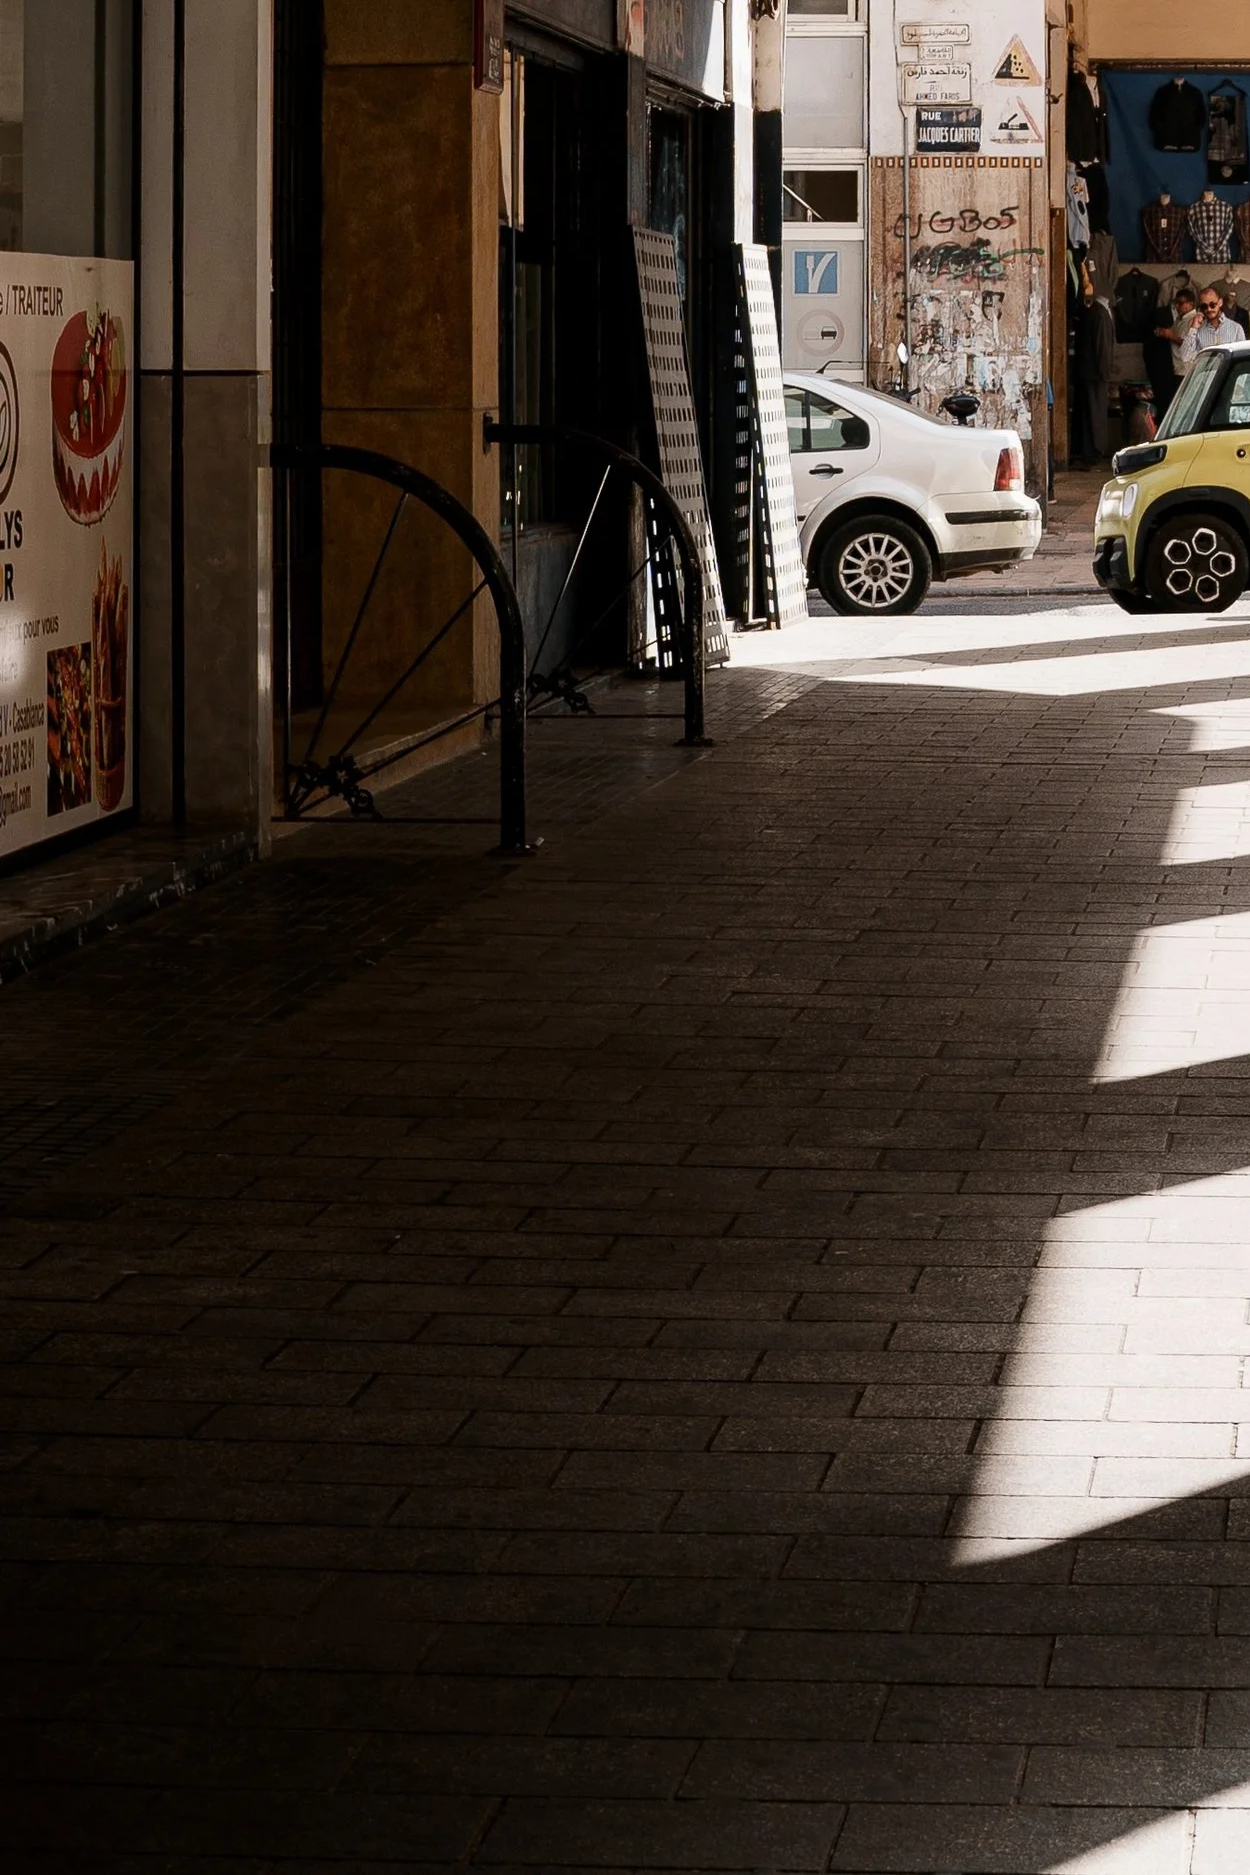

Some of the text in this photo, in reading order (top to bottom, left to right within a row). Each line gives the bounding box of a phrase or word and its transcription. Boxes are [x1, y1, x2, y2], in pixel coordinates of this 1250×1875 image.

[921, 111, 942, 121] RUE
[918, 126, 981, 145] JACQUES CARTIER
[12, 285, 64, 316] TRAITEUR
[23, 619, 41, 645] pour
[41, 615, 59, 637] vous
[12, 697, 44, 734] Casablanca
